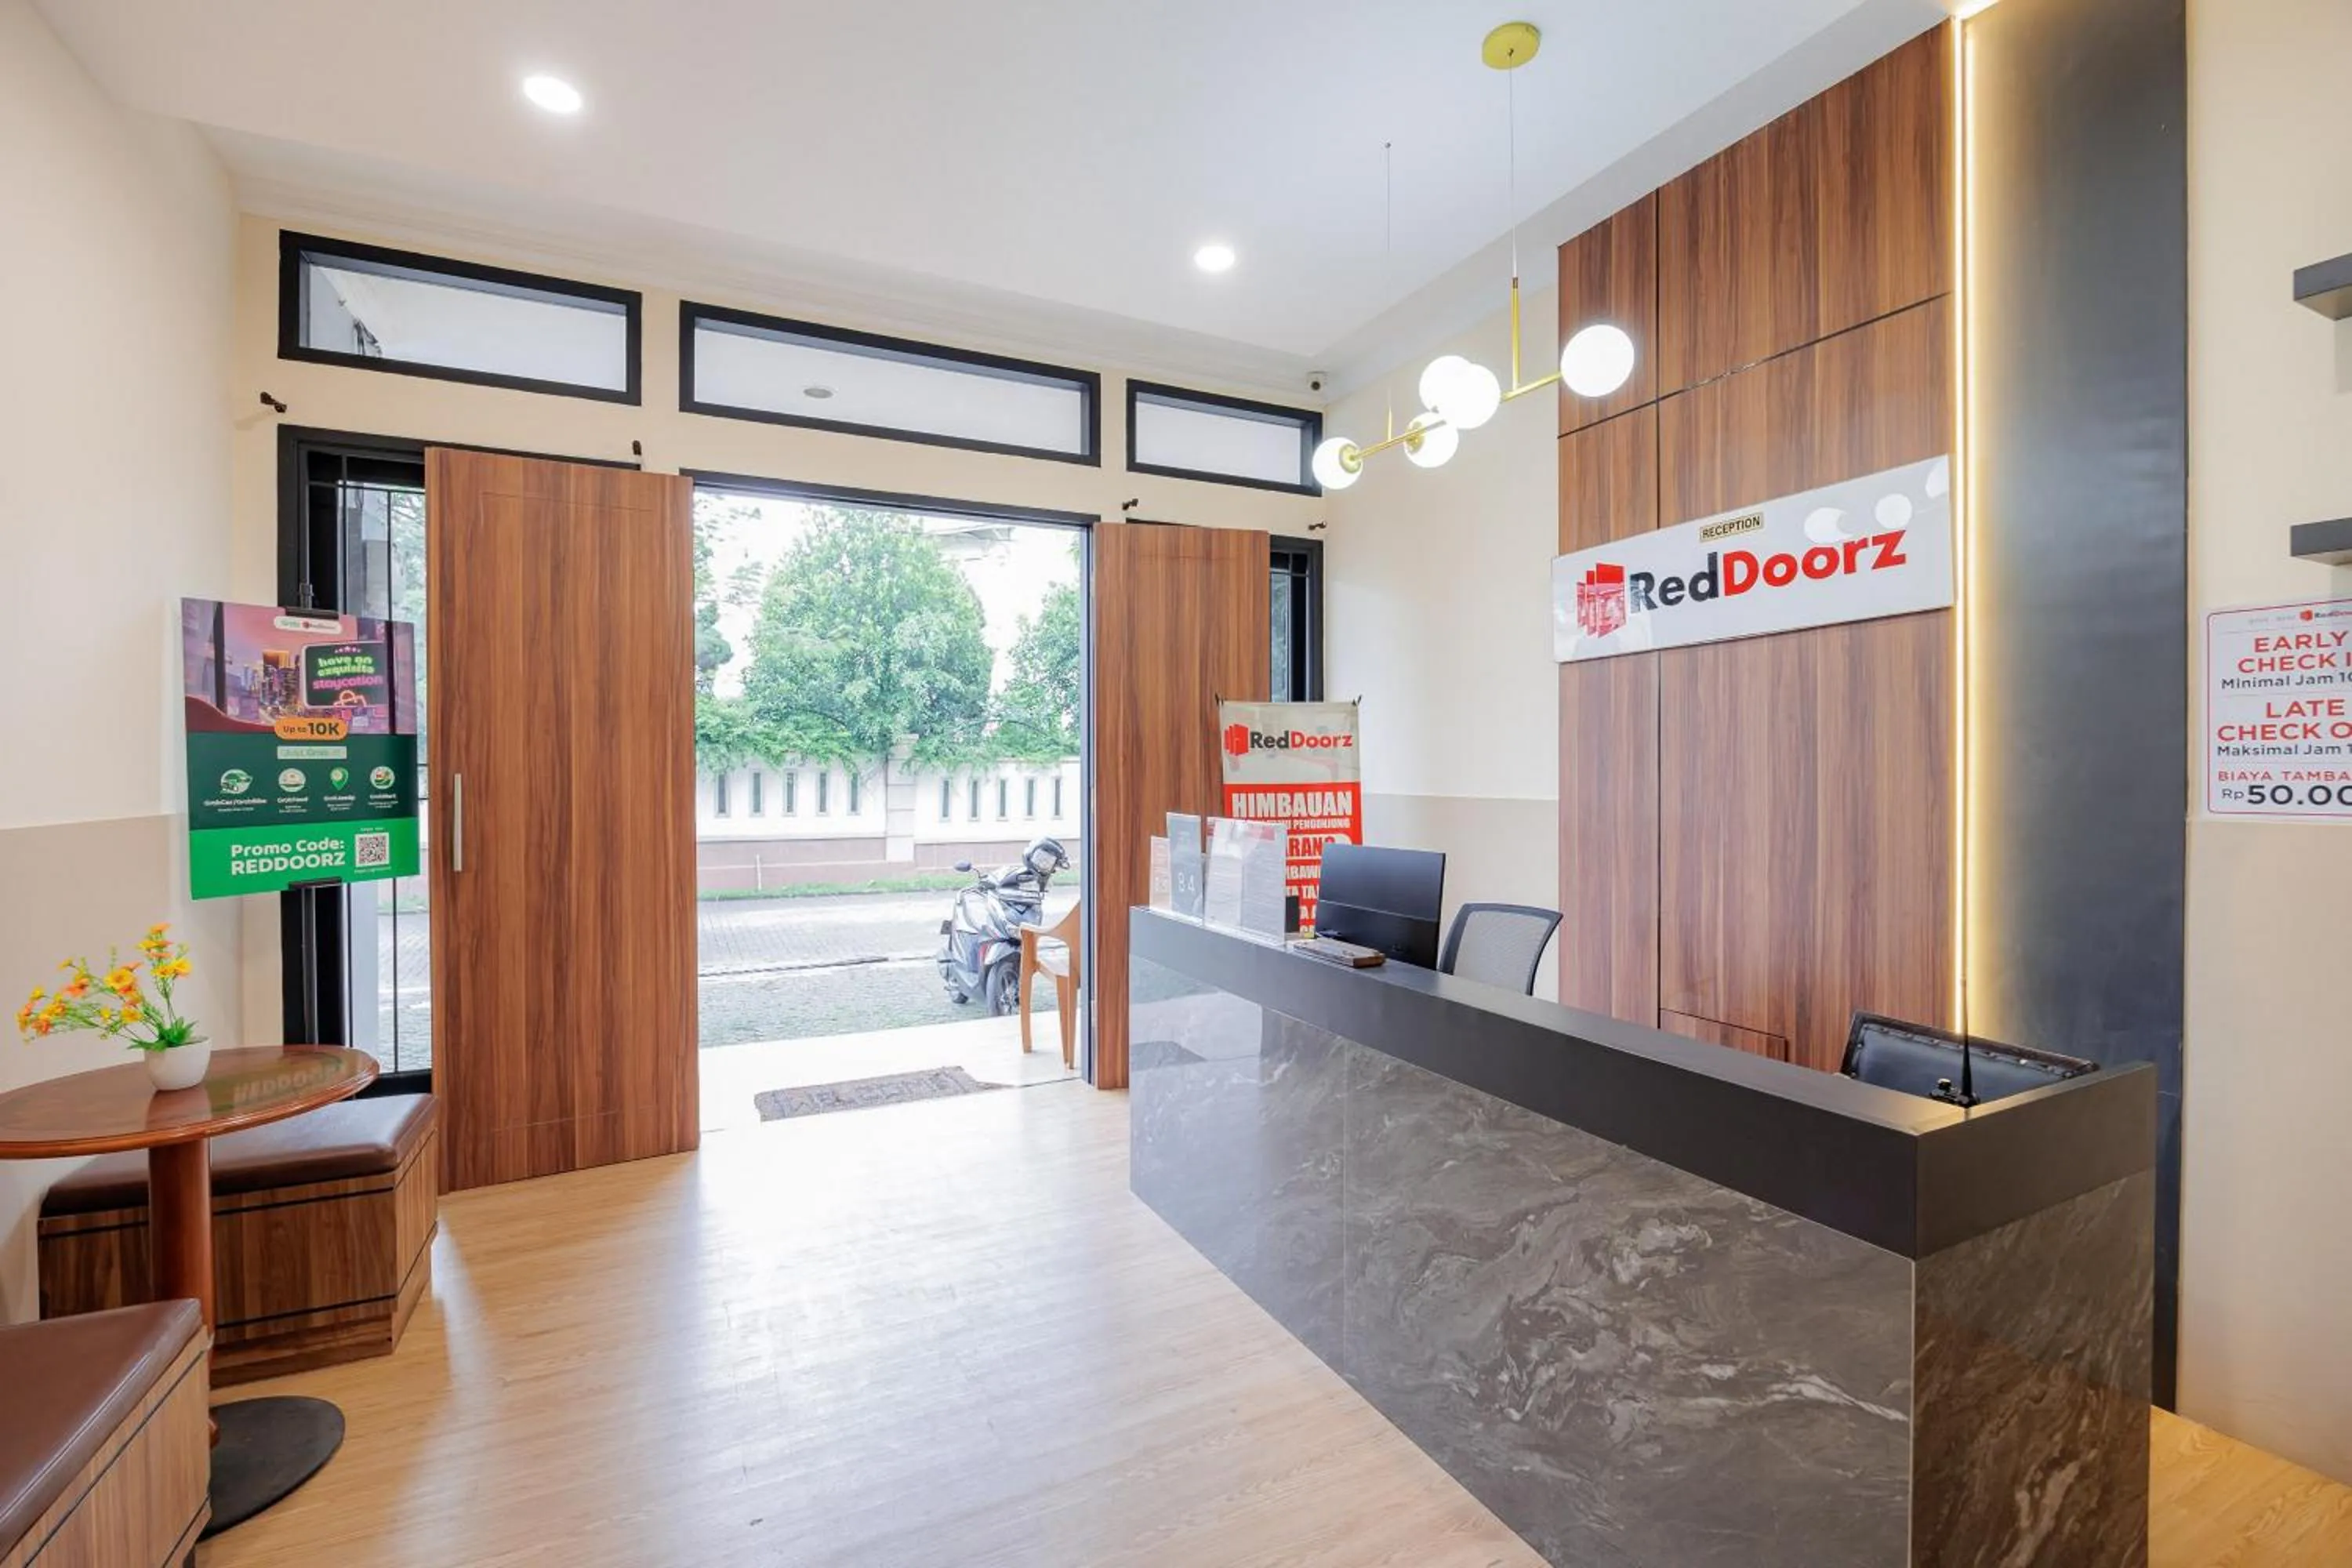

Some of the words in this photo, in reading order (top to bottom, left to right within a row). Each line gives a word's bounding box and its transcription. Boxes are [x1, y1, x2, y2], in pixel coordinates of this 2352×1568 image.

[1702, 516, 1760, 539] RECEPTION
[1630, 529, 1907, 614] RedDoorz
[2254, 630, 2349, 652] EARLY
[2238, 652, 2336, 673] CHECK
[313, 675, 383, 690] staycation
[2221, 675, 2290, 688] Minimal
[2296, 674, 2333, 686] Jam
[2266, 699, 2345, 718] LATE
[283, 724, 296, 734] Up
[307, 722, 339, 736] 10K
[2217, 722, 2321, 741] CHECK
[1250, 730, 1352, 750] RedDoorz
[2217, 744, 2298, 756] Maksimal
[2303, 744, 2341, 755] Jam
[2218, 771, 2273, 782] BIAYA
[2281, 771, 2350, 782] TAMBA
[1232, 791, 1352, 818] HIMBAUAN
[230, 843, 292, 858] Promo
[296, 837, 345, 853] Code:
[230, 851, 346, 876] REDDOORZ
